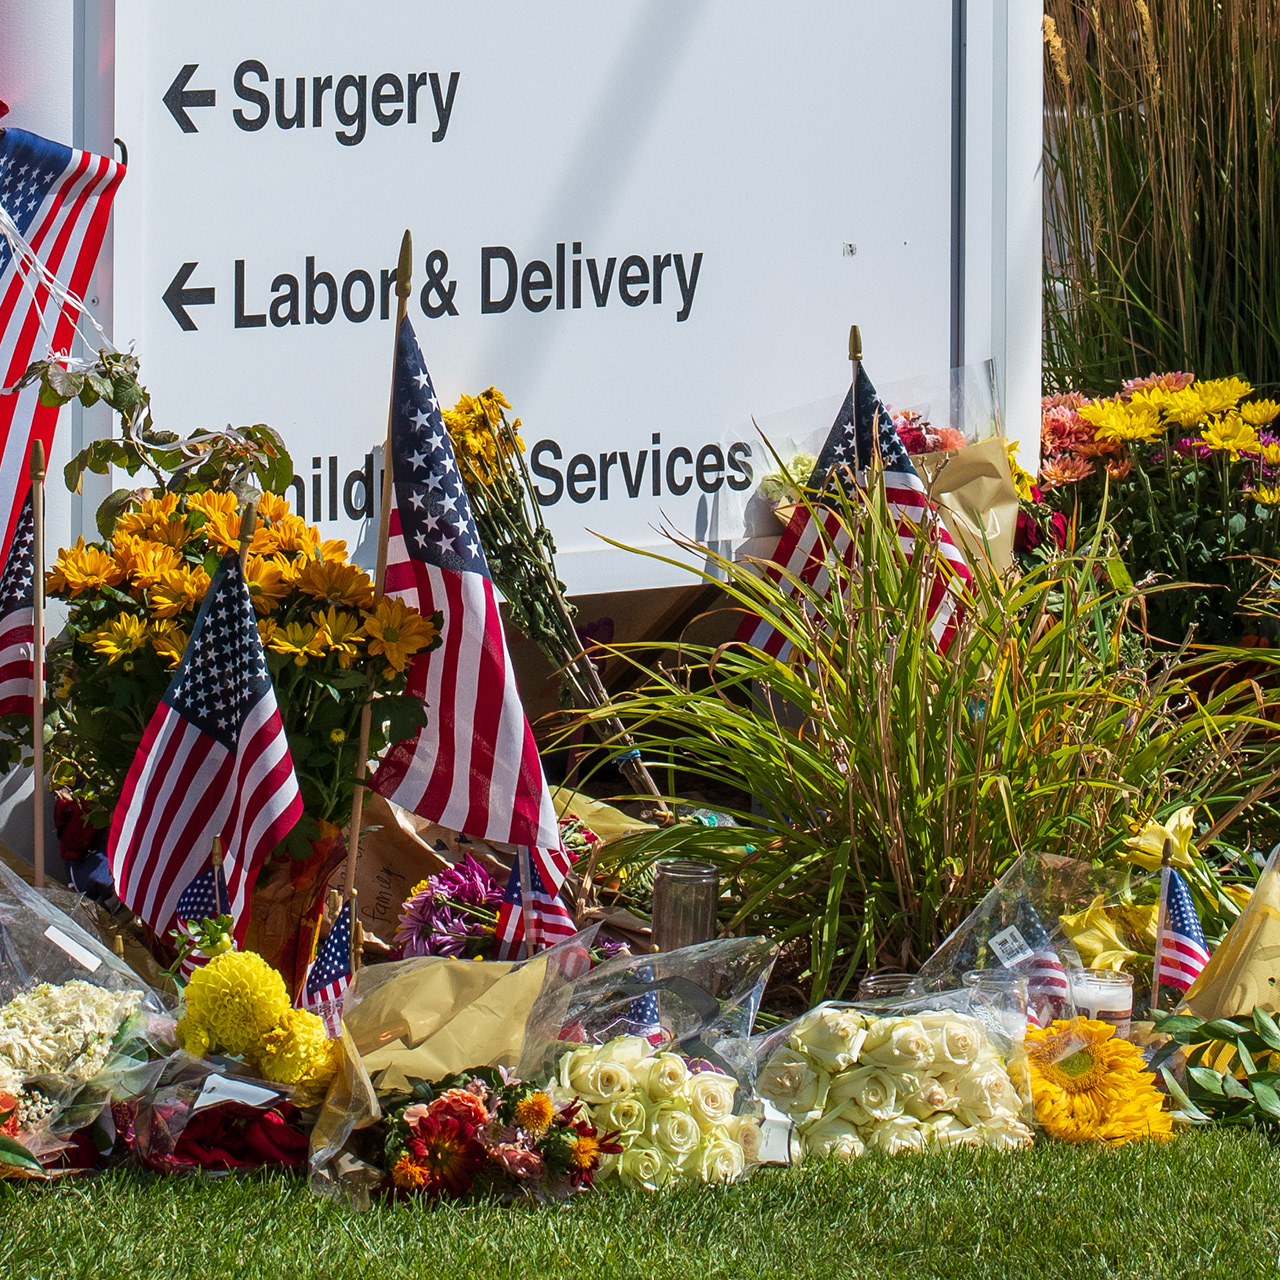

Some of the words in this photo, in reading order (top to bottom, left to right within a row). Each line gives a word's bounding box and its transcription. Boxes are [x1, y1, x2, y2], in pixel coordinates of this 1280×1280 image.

[231, 58, 461, 147] Surgery
[233, 254, 398, 330] Labor
[419, 248, 461, 319] &
[480, 240, 705, 324] Delivery
[530, 431, 754, 507] Services
